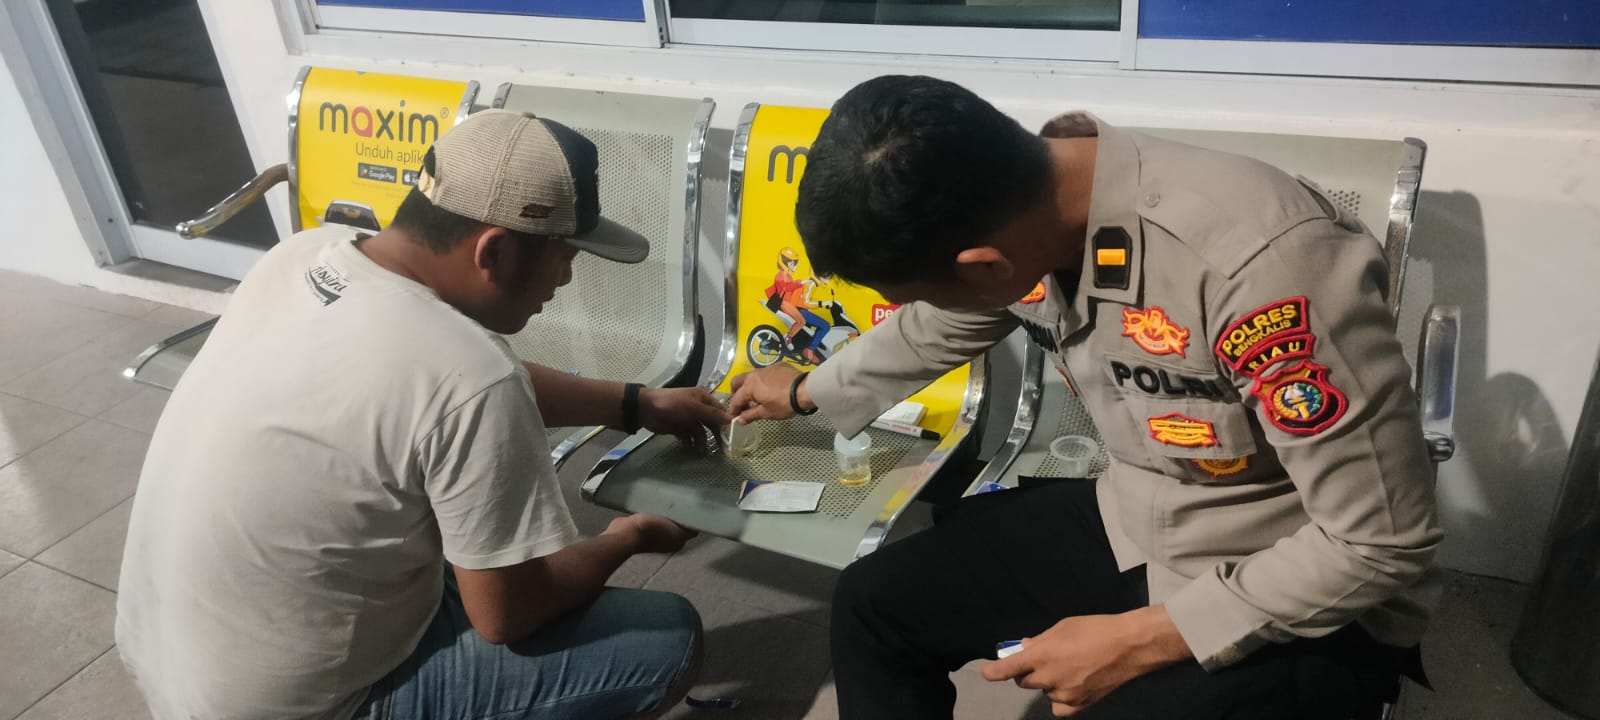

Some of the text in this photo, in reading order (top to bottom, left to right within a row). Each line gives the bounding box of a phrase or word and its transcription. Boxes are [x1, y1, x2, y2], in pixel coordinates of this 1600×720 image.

[319, 99, 439, 145] maxim
[355, 142, 424, 165] Unduh aplik
[875, 308, 894, 321] pe
[1222, 304, 1297, 356] POLRES
[1233, 319, 1292, 357] BENGKALIS
